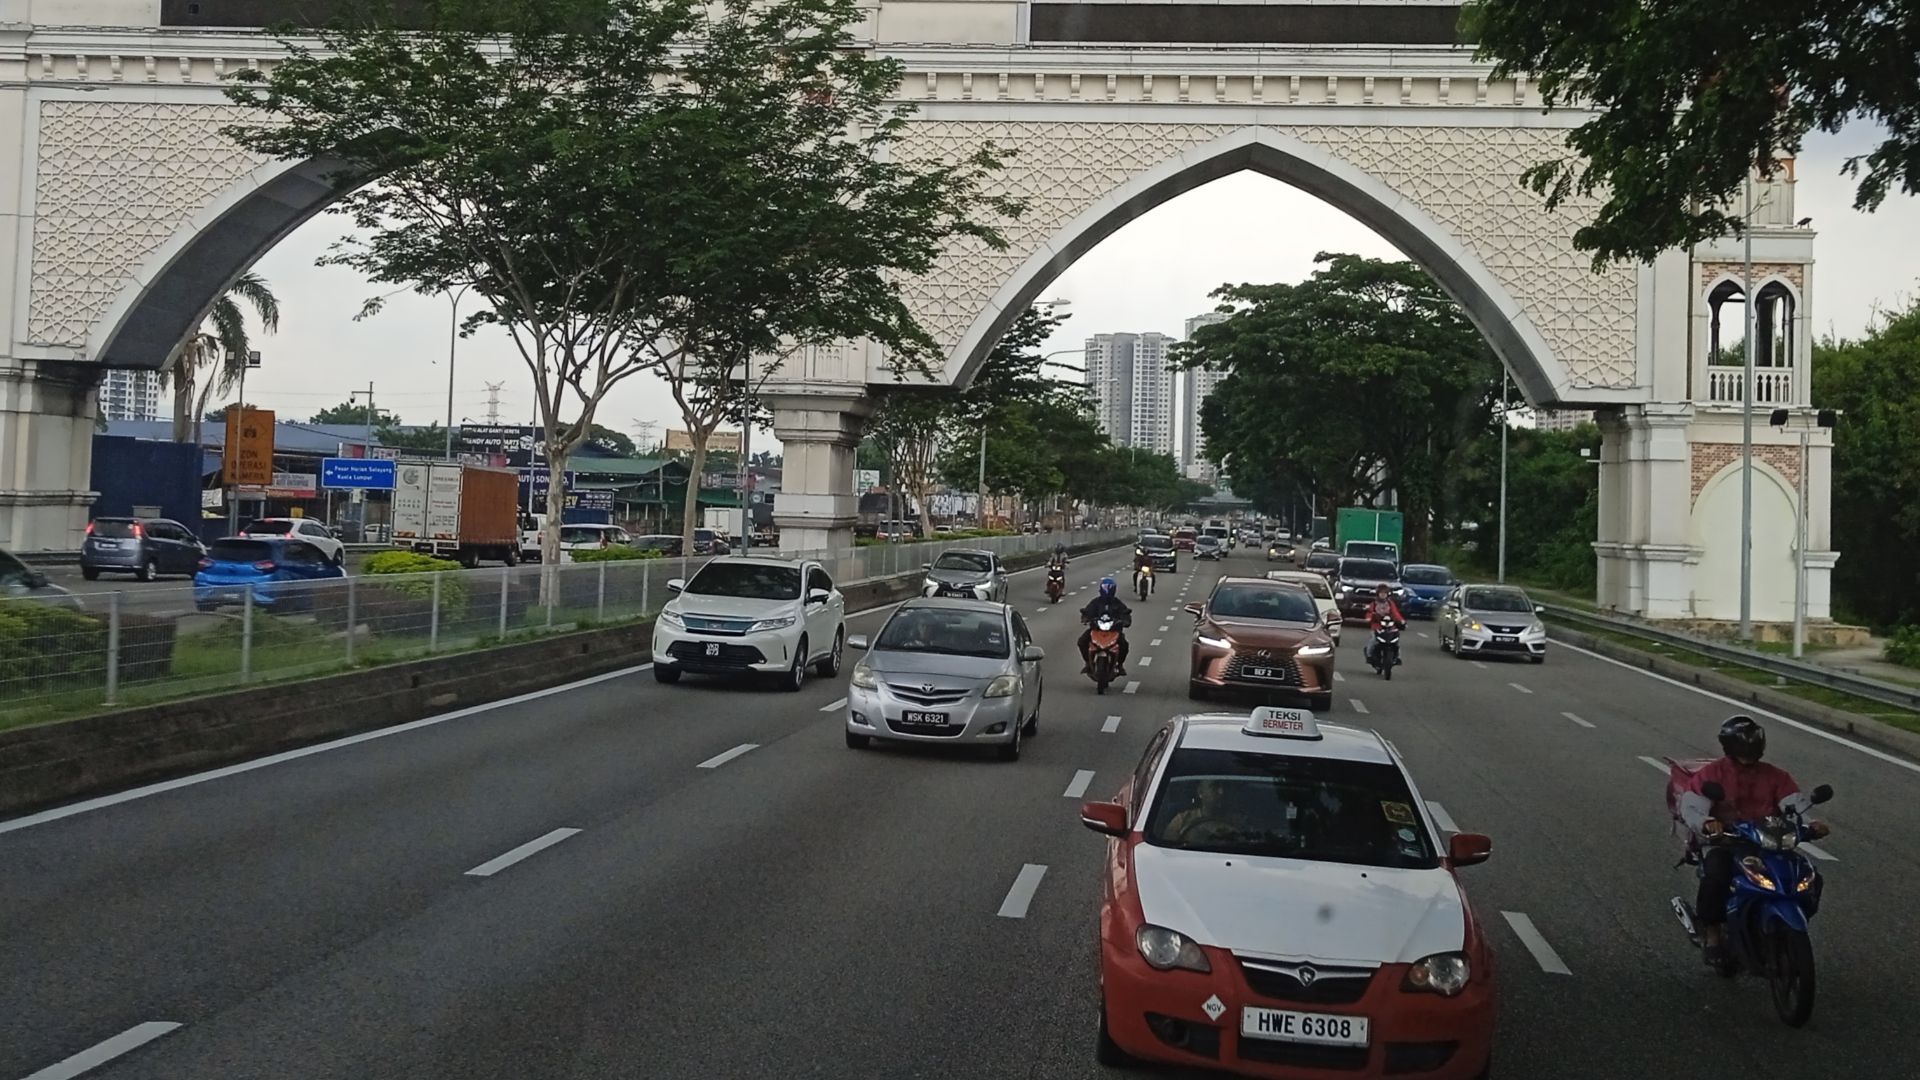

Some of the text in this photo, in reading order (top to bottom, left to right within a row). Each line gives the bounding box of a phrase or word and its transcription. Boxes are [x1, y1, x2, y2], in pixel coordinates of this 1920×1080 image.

[368, 466, 392, 474] Selayang
[924, 713, 944, 723] 6321
[1268, 710, 1301, 721] TEKSI
[1263, 719, 1304, 731] BERMETER
[1206, 1004, 1222, 1012] NGV
[1258, 1012, 1351, 1039] HWE 6308
